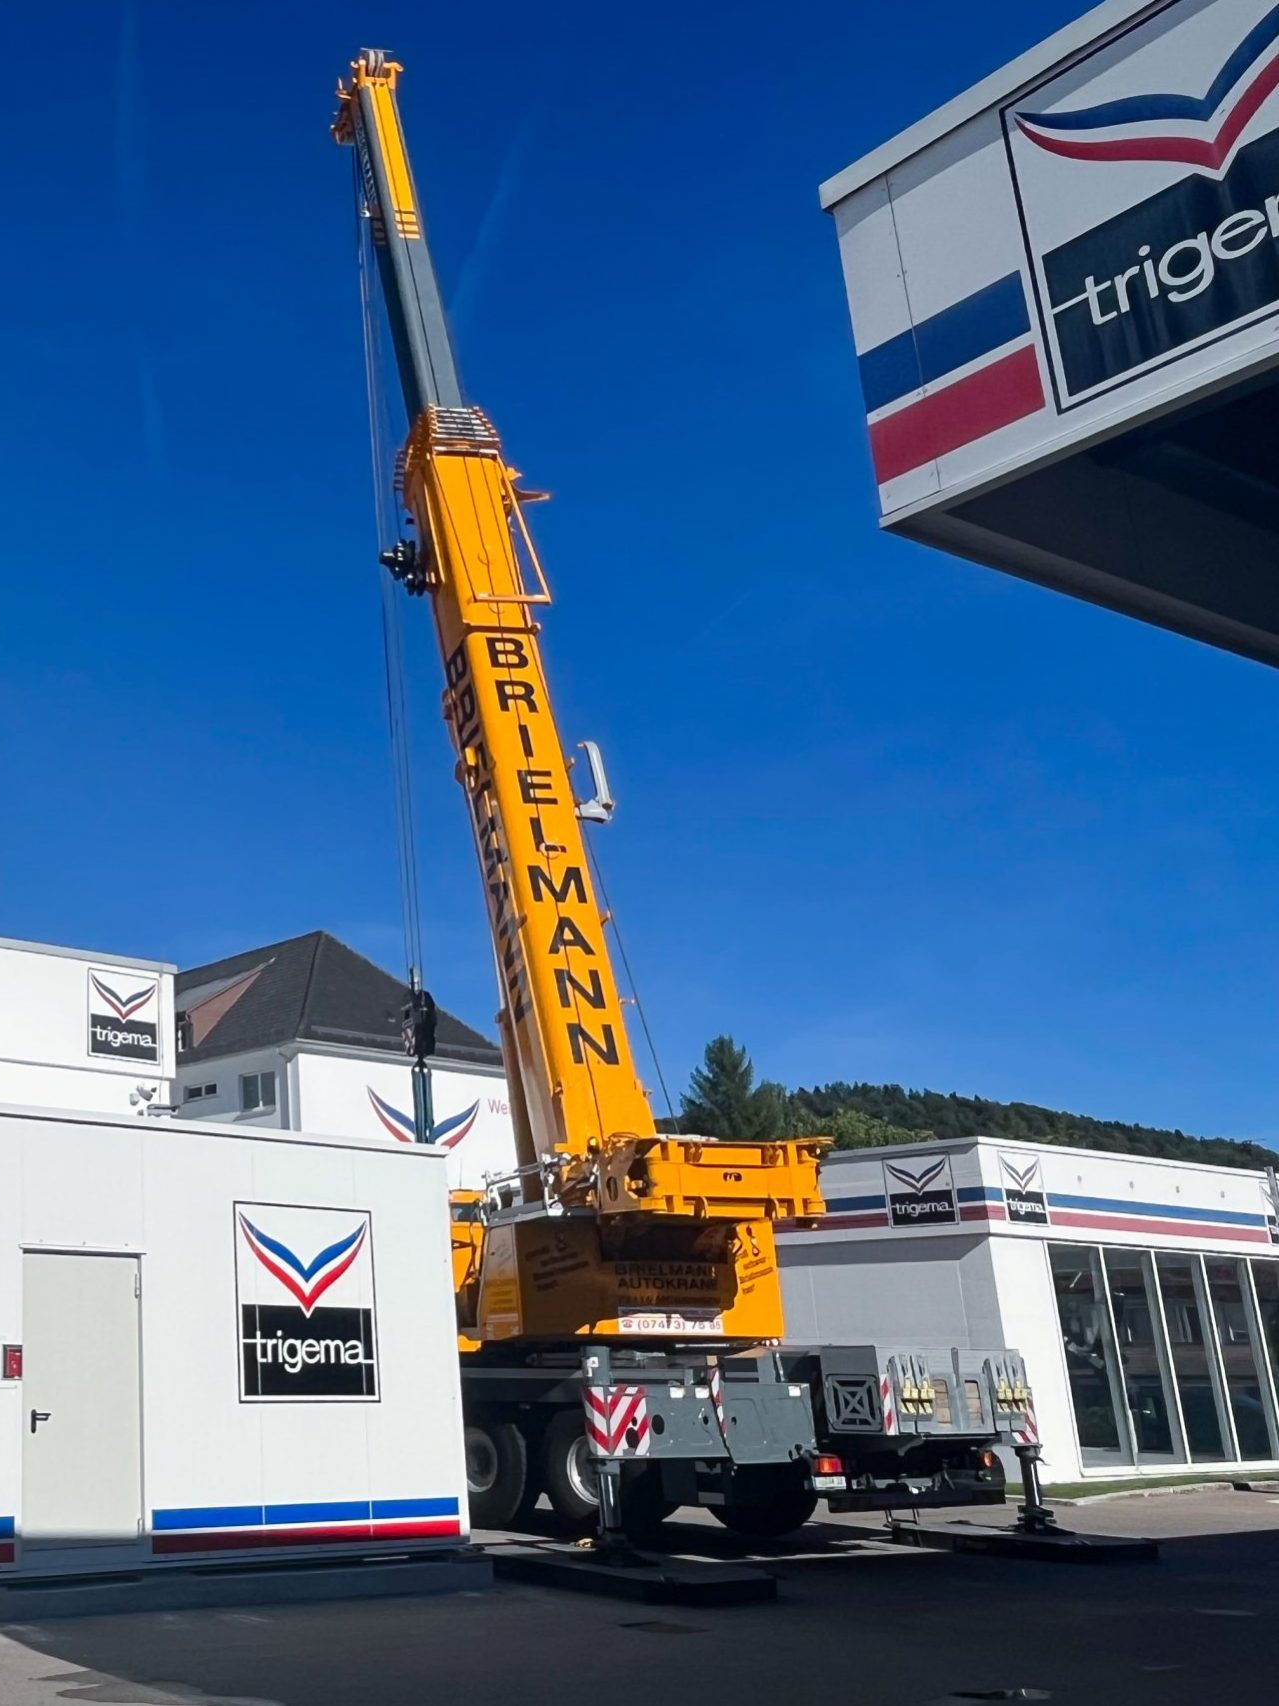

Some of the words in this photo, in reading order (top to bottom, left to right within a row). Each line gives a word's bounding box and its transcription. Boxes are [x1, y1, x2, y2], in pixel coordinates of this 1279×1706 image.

[485, 637, 620, 1065] BRIELMANN
[93, 1025, 155, 1047] trigema
[893, 1201, 952, 1216] trigema
[247, 1330, 370, 1373] trigema
